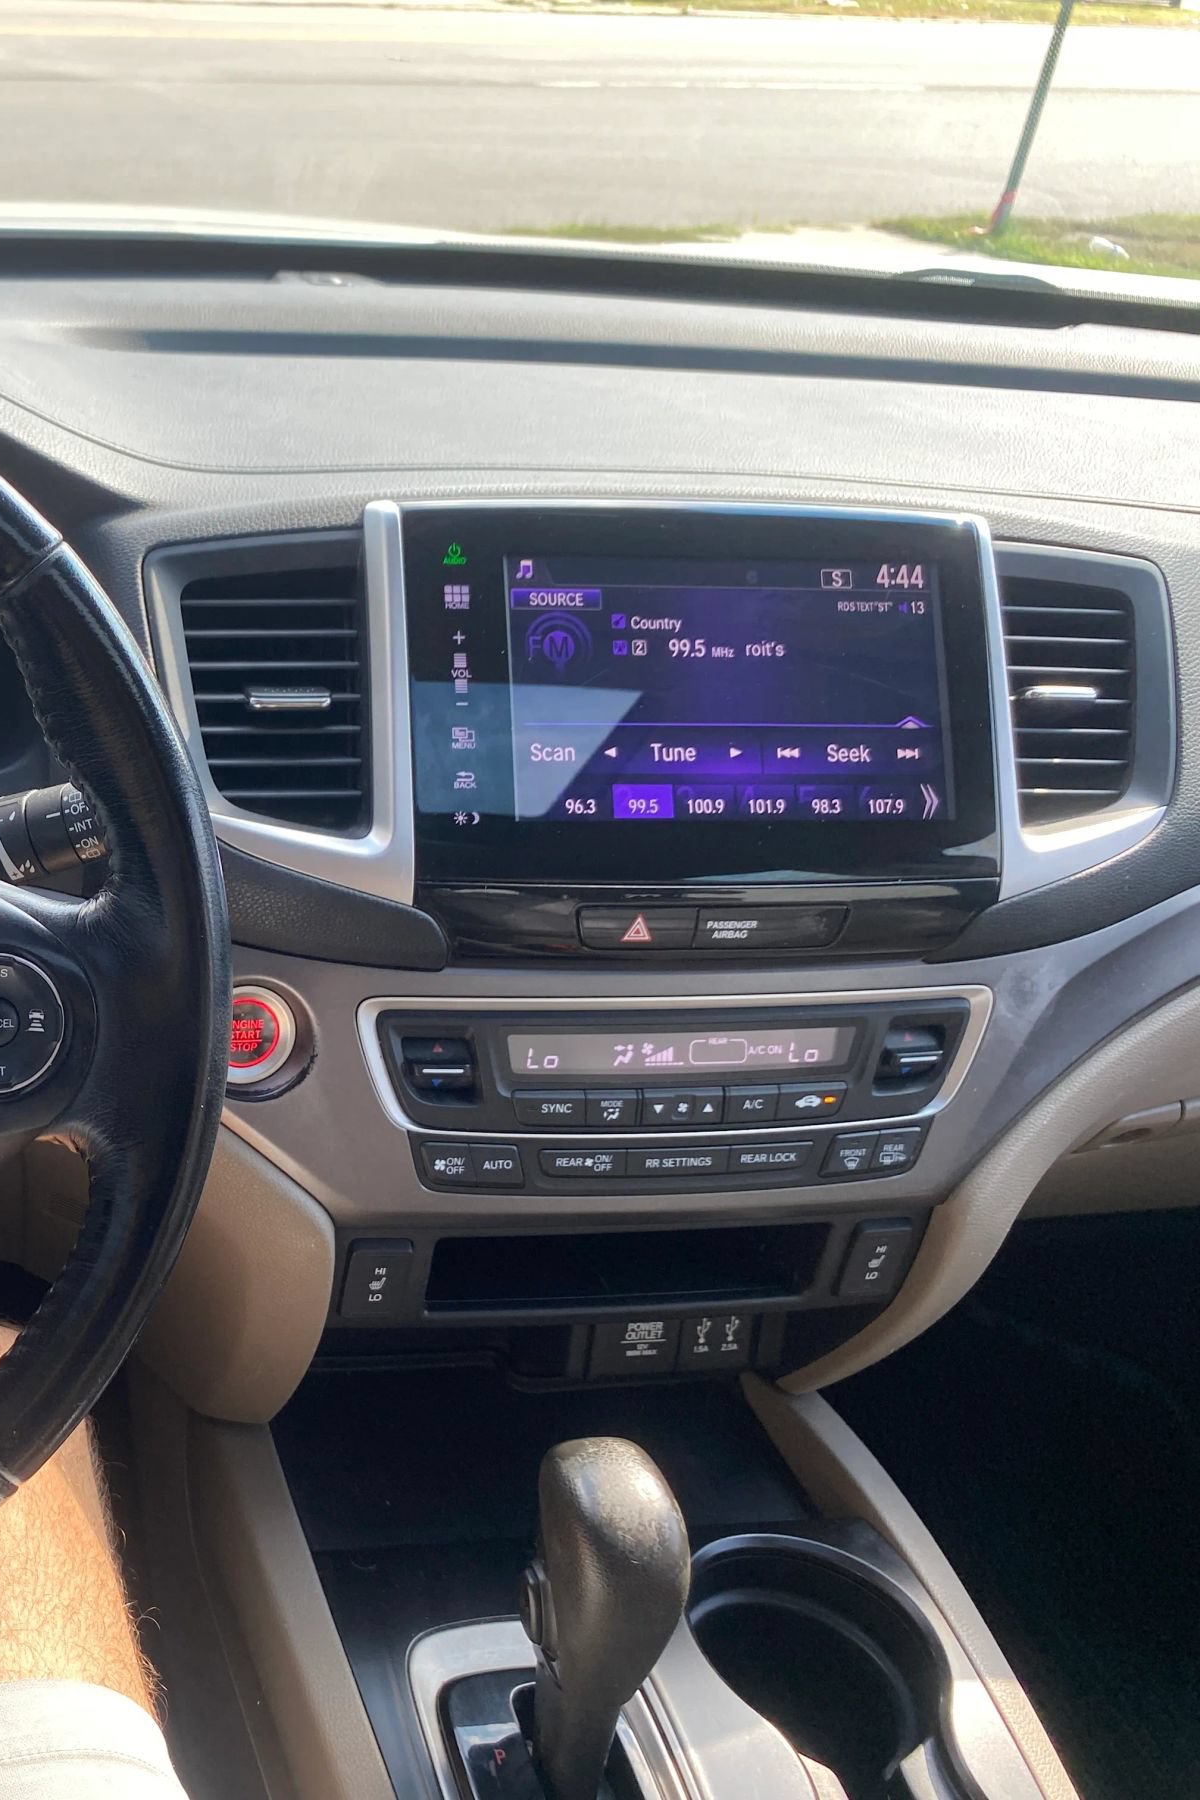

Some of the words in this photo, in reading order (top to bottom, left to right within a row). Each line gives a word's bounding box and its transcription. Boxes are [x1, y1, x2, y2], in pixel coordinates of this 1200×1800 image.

[443, 556, 468, 566] AUDIO
[831, 570, 843, 588] S
[876, 564, 924, 589] 4:44
[529, 592, 584, 607] SOURCE
[444, 602, 470, 610] HOME
[837, 601, 855, 612] RDS
[856, 602, 874, 612] TEXT
[910, 602, 925, 614] 13
[630, 616, 682, 633] Country
[528, 636, 570, 661] FM
[668, 638, 706, 658] 99.5
[712, 646, 736, 658] MHz
[746, 640, 786, 657] roit's
[450, 669, 472, 678] VOL
[452, 742, 476, 750] MENU
[530, 743, 576, 762] Scan
[650, 743, 697, 762] Tune
[826, 744, 871, 763] Seek
[70, 804, 89, 815] OF
[565, 798, 596, 814] 96.3
[628, 799, 659, 814] 99.5
[687, 798, 725, 814] 100.9
[748, 798, 785, 814] 101.9
[811, 798, 842, 814] 98.3
[868, 798, 904, 814] 107.9
[74, 818, 93, 832] INT
[80, 836, 99, 848] ON
[706, 920, 758, 930] PASSENGER
[712, 930, 748, 940] AIRBAG
[231, 1018, 264, 1030] NGINE
[230, 1042, 258, 1052] STOP
[748, 1046, 766, 1055] A/C
[767, 1045, 783, 1054] ON
[541, 1103, 573, 1114] SYNC
[600, 1100, 624, 1108] MODE
[742, 1099, 764, 1110] A/C
[840, 1148, 867, 1157] FRONT
[883, 1144, 905, 1152] REAR
[446, 1157, 465, 1166] ON/
[555, 1158, 584, 1167] REAR
[594, 1154, 614, 1164] ON/
[645, 1158, 661, 1168] RR
[662, 1156, 712, 1168] SETTINGS
[740, 1154, 768, 1164] REAR
[769, 1152, 797, 1162] LOCK
[446, 1166, 465, 1175] OFF
[482, 1160, 513, 1170] AUTO
[593, 1163, 613, 1172] OFF
[876, 1244, 888, 1254] HI
[374, 1268, 387, 1276] HI
[864, 1271, 878, 1280] LO
[368, 1294, 382, 1302] LO
[627, 1321, 664, 1332] POWER
[625, 1330, 663, 1340] OUTLET
[493, 1748, 506, 1766] P
